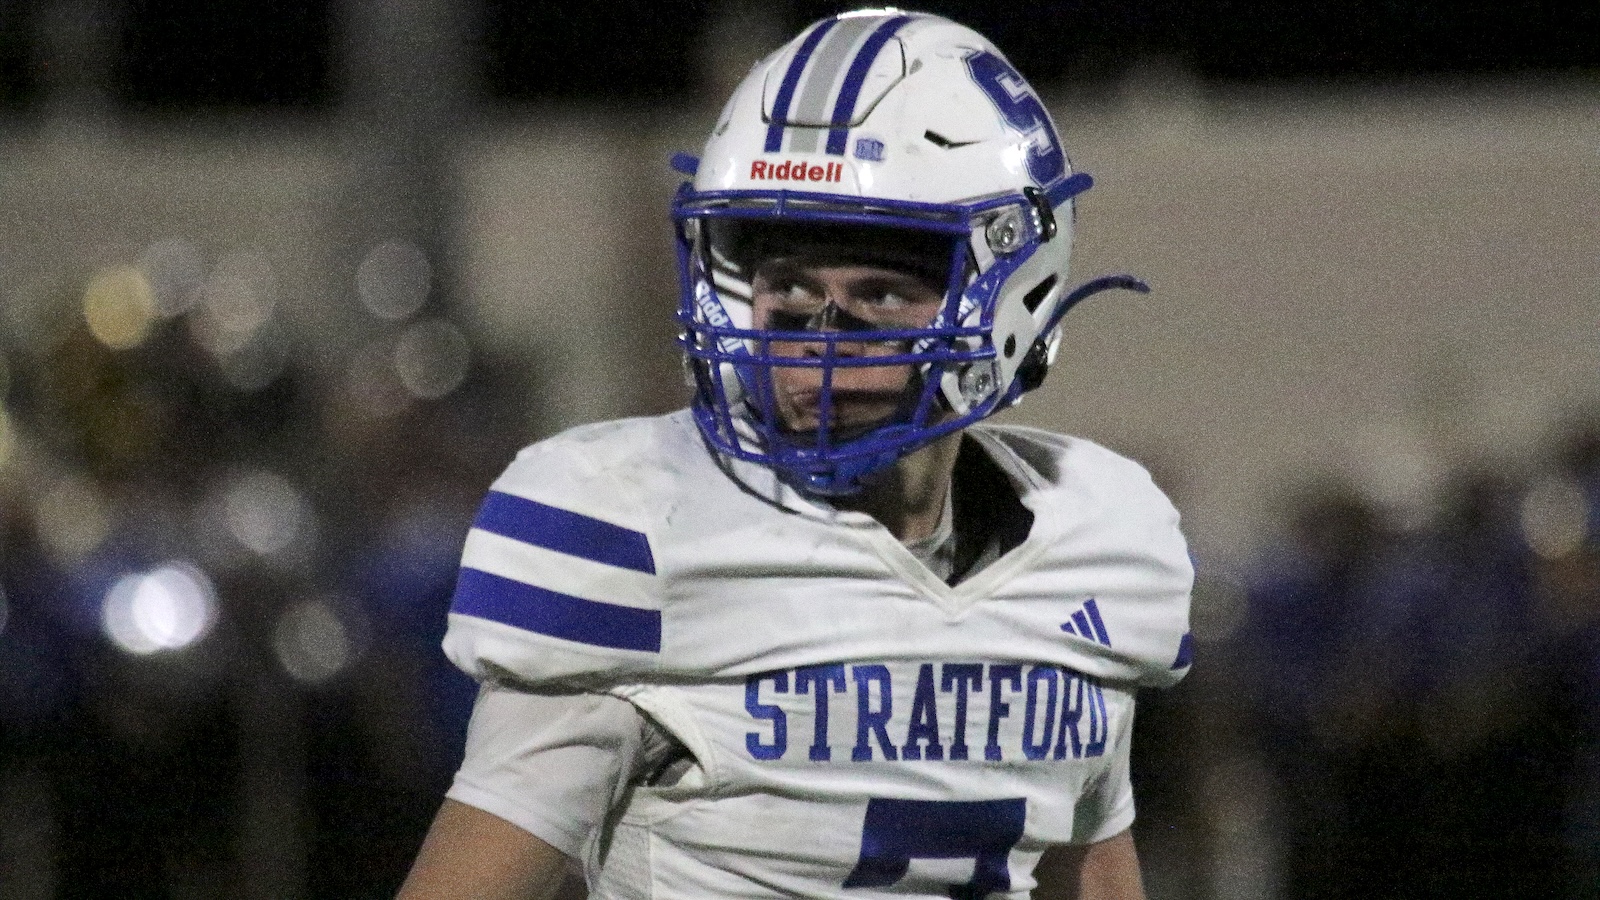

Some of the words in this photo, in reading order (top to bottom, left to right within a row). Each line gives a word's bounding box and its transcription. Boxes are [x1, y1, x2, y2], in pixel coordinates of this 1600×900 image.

[964, 50, 1066, 188] S
[750, 160, 843, 182] Riddell
[745, 663, 1108, 761] STRATFORD
